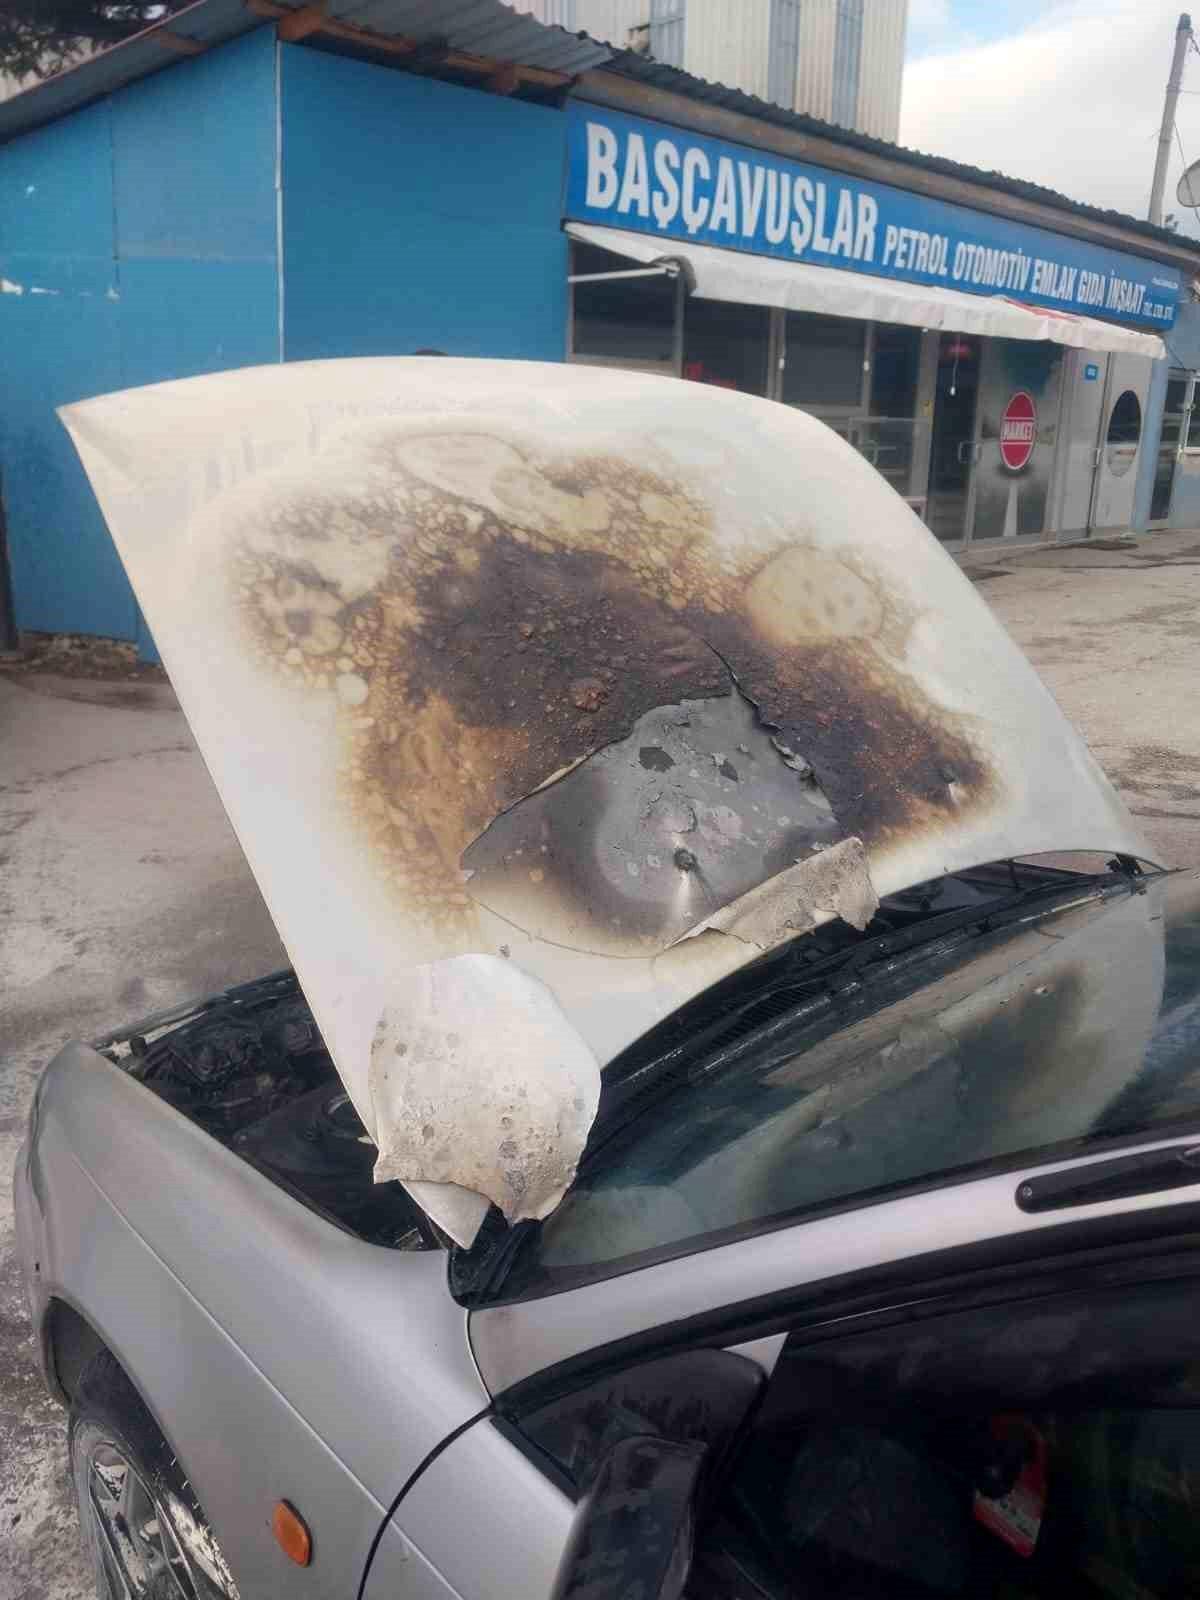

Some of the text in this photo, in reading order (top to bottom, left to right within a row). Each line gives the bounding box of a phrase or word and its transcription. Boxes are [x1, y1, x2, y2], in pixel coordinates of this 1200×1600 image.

[586, 121, 878, 262] BAŞÇAVUŞLAR
[882, 224, 949, 276] PETROL
[953, 241, 1032, 291] OTOMOTİV
[1030, 258, 1078, 301] EMLAK
[1076, 269, 1106, 306] GIDA
